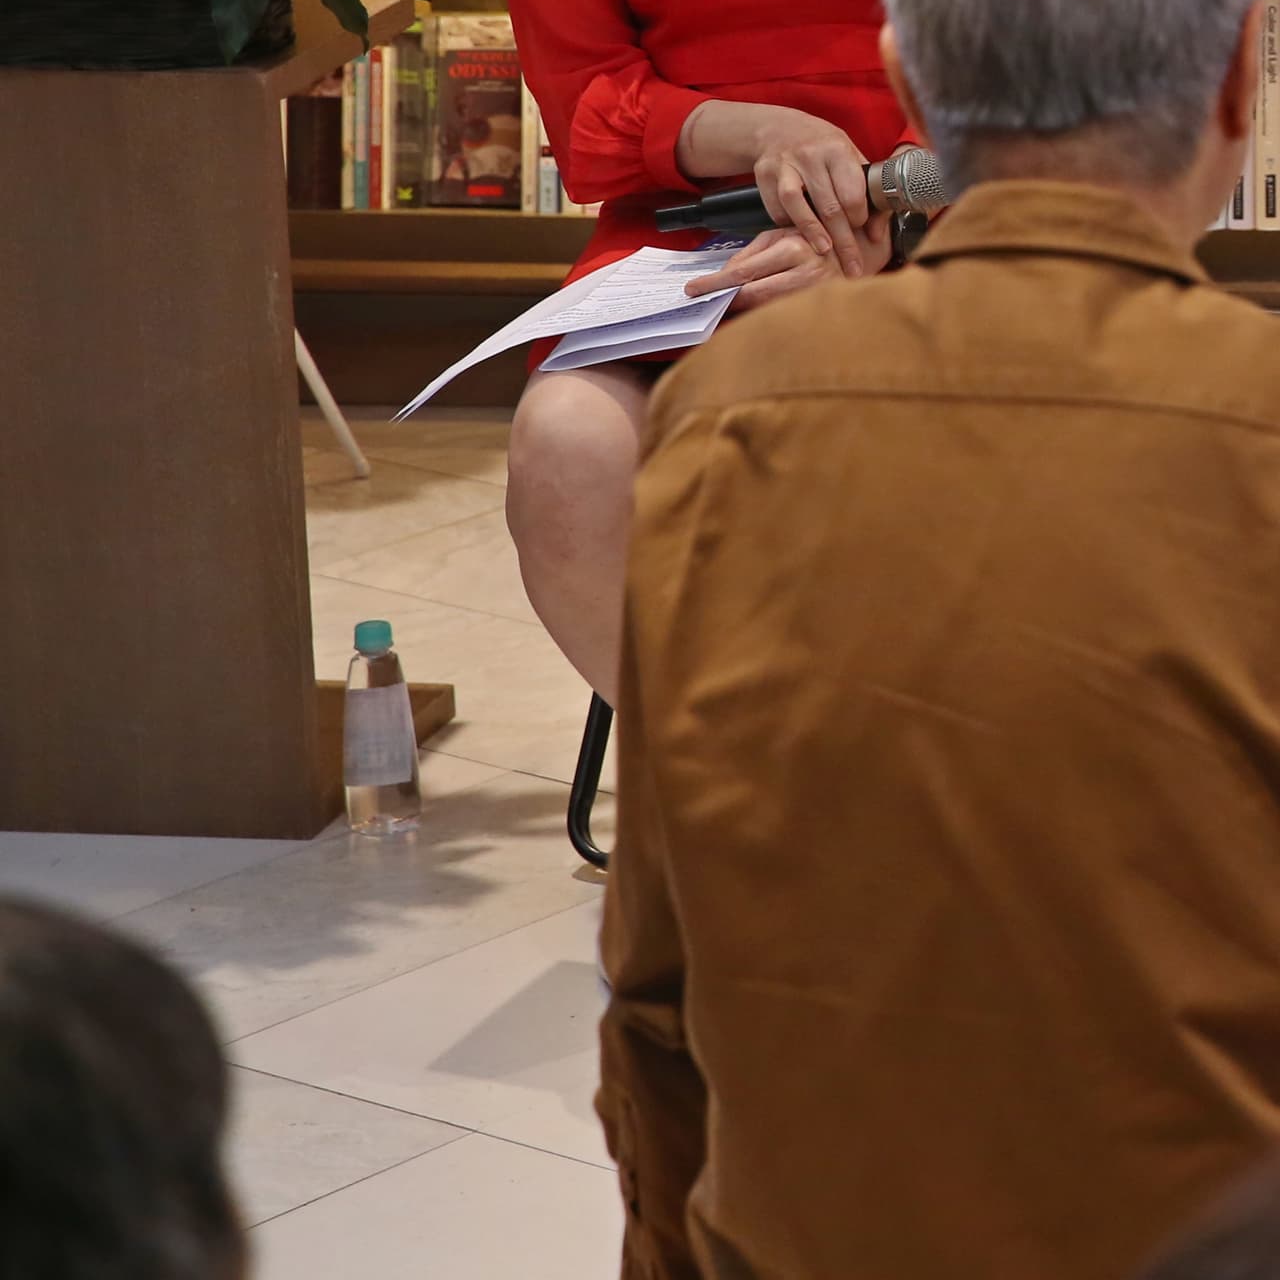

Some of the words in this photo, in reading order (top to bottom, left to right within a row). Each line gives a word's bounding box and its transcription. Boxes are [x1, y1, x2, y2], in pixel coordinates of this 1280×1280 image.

[1266, 5, 1278, 34] Color
[1266, 35, 1278, 56] and
[1265, 57, 1278, 84] Light
